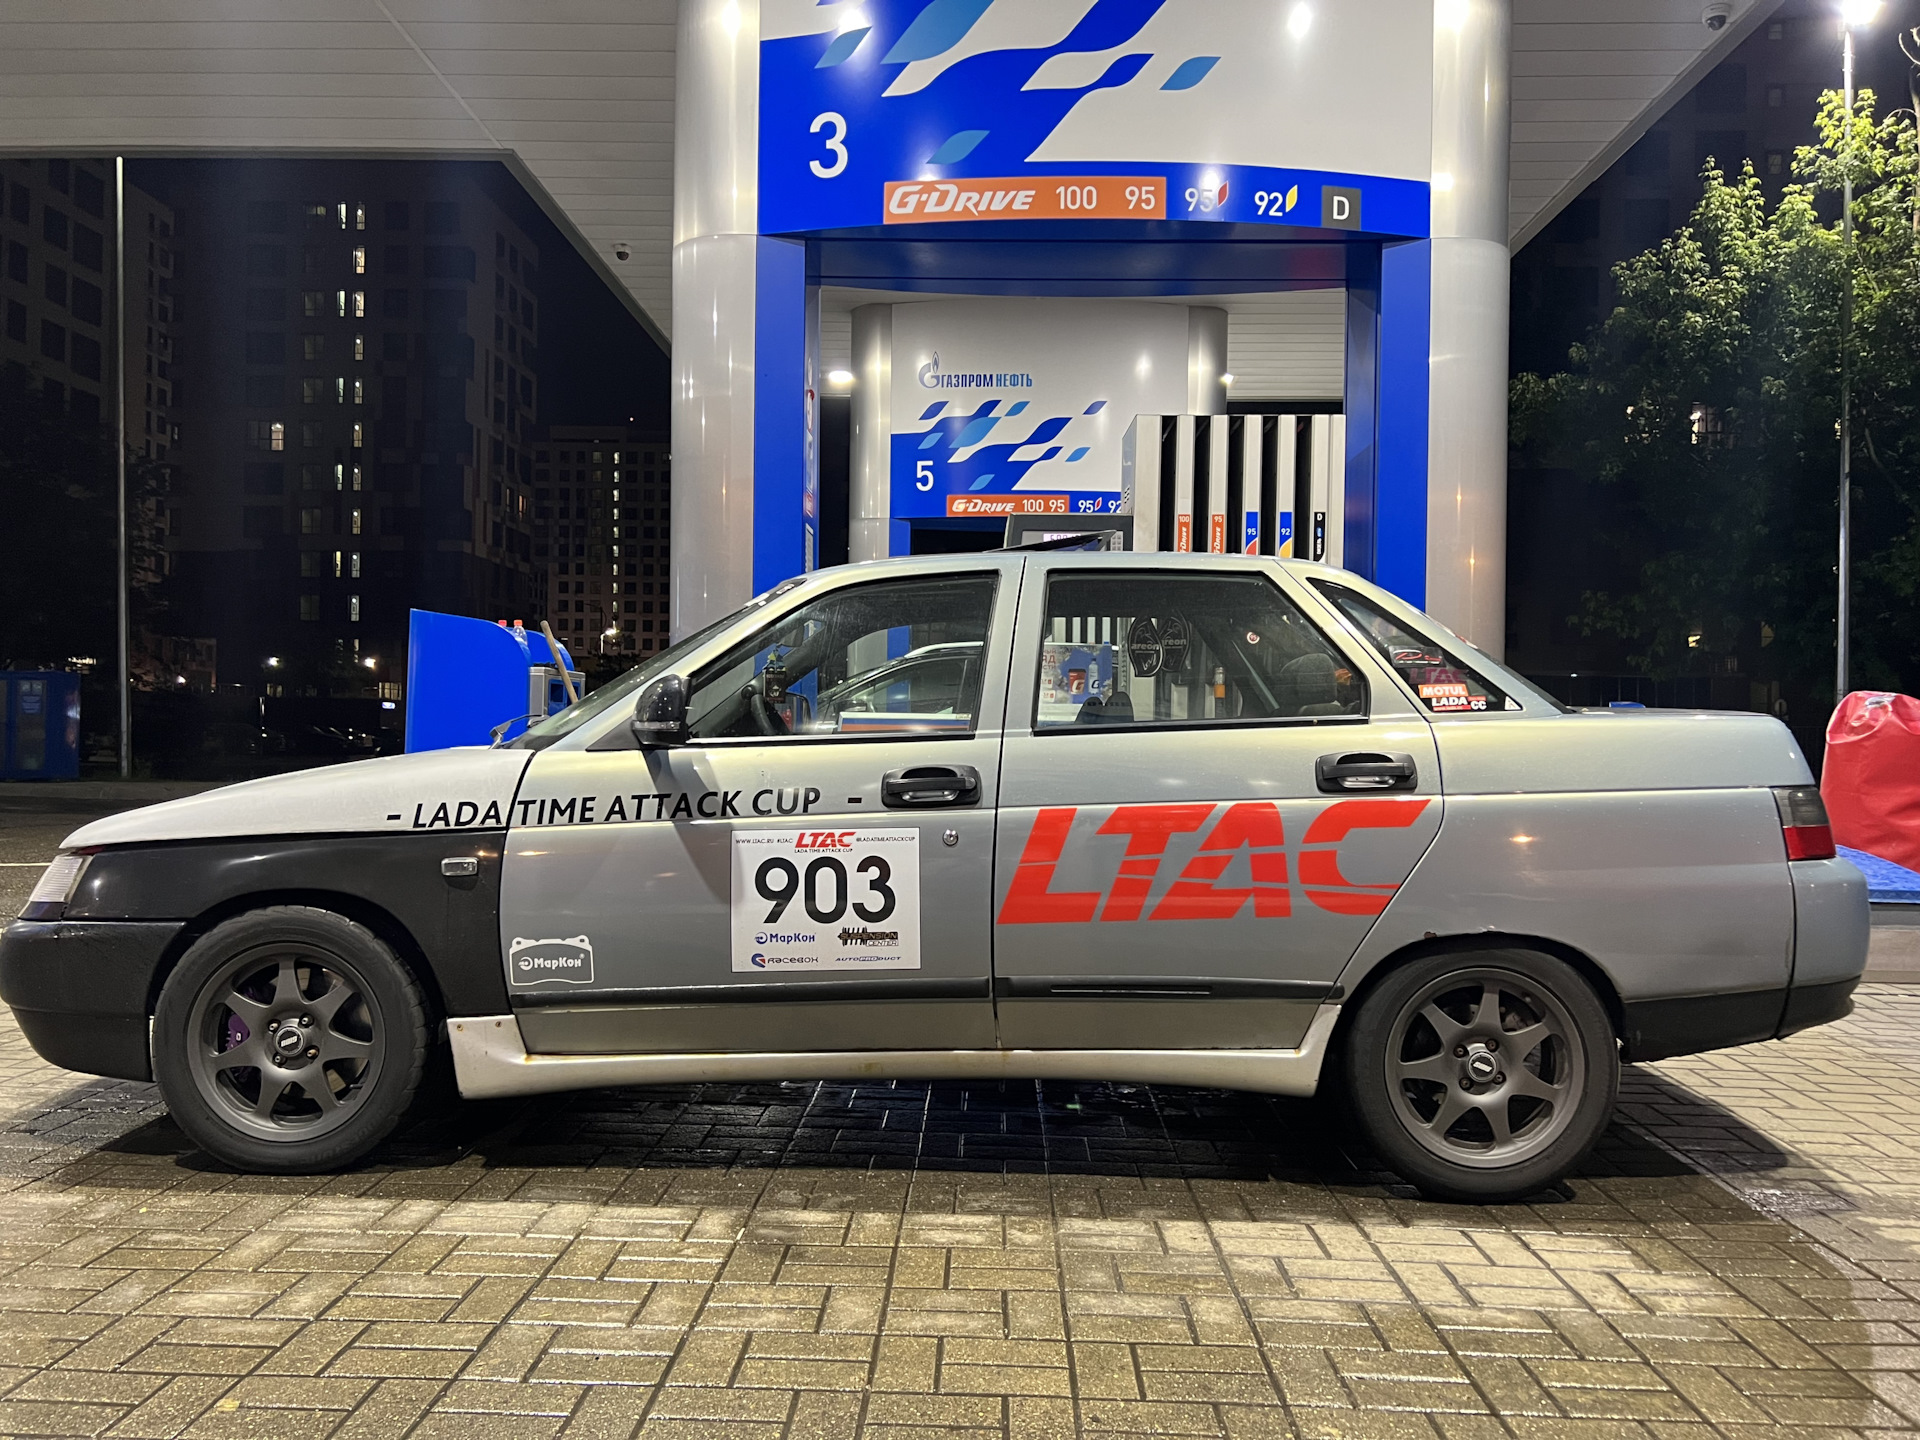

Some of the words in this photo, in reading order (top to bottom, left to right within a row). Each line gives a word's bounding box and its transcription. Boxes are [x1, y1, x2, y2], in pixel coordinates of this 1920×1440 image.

[809, 112, 848, 178] 3
[1056, 186, 1097, 210] 100
[1125, 186, 1156, 210] 95
[1185, 188, 1215, 212] 95
[1254, 191, 1283, 217] 92
[1332, 196, 1350, 220] D
[941, 374, 993, 388] ГАЗПРОМ
[996, 373, 1032, 388] НЕФТЬ
[916, 460, 934, 491] 5
[1022, 500, 1044, 512] 100
[1049, 500, 1065, 512] 95
[1078, 501, 1094, 513] 95
[1179, 515, 1190, 523] 100
[1214, 515, 1223, 523] 95
[1316, 513, 1323, 521] D
[1247, 528, 1257, 536] 95
[1281, 528, 1291, 536] 92
[1423, 686, 1466, 696] MOTUL
[1432, 697, 1468, 707] LADA
[1470, 701, 1487, 710] CC
[412, 802, 503, 828] LADA
[515, 796, 596, 825] TIME
[603, 790, 742, 823] ATTACK
[752, 787, 821, 815] CUP
[795, 832, 856, 848] LTAC
[996, 799, 1431, 925] LTAC
[755, 855, 896, 924] 903
